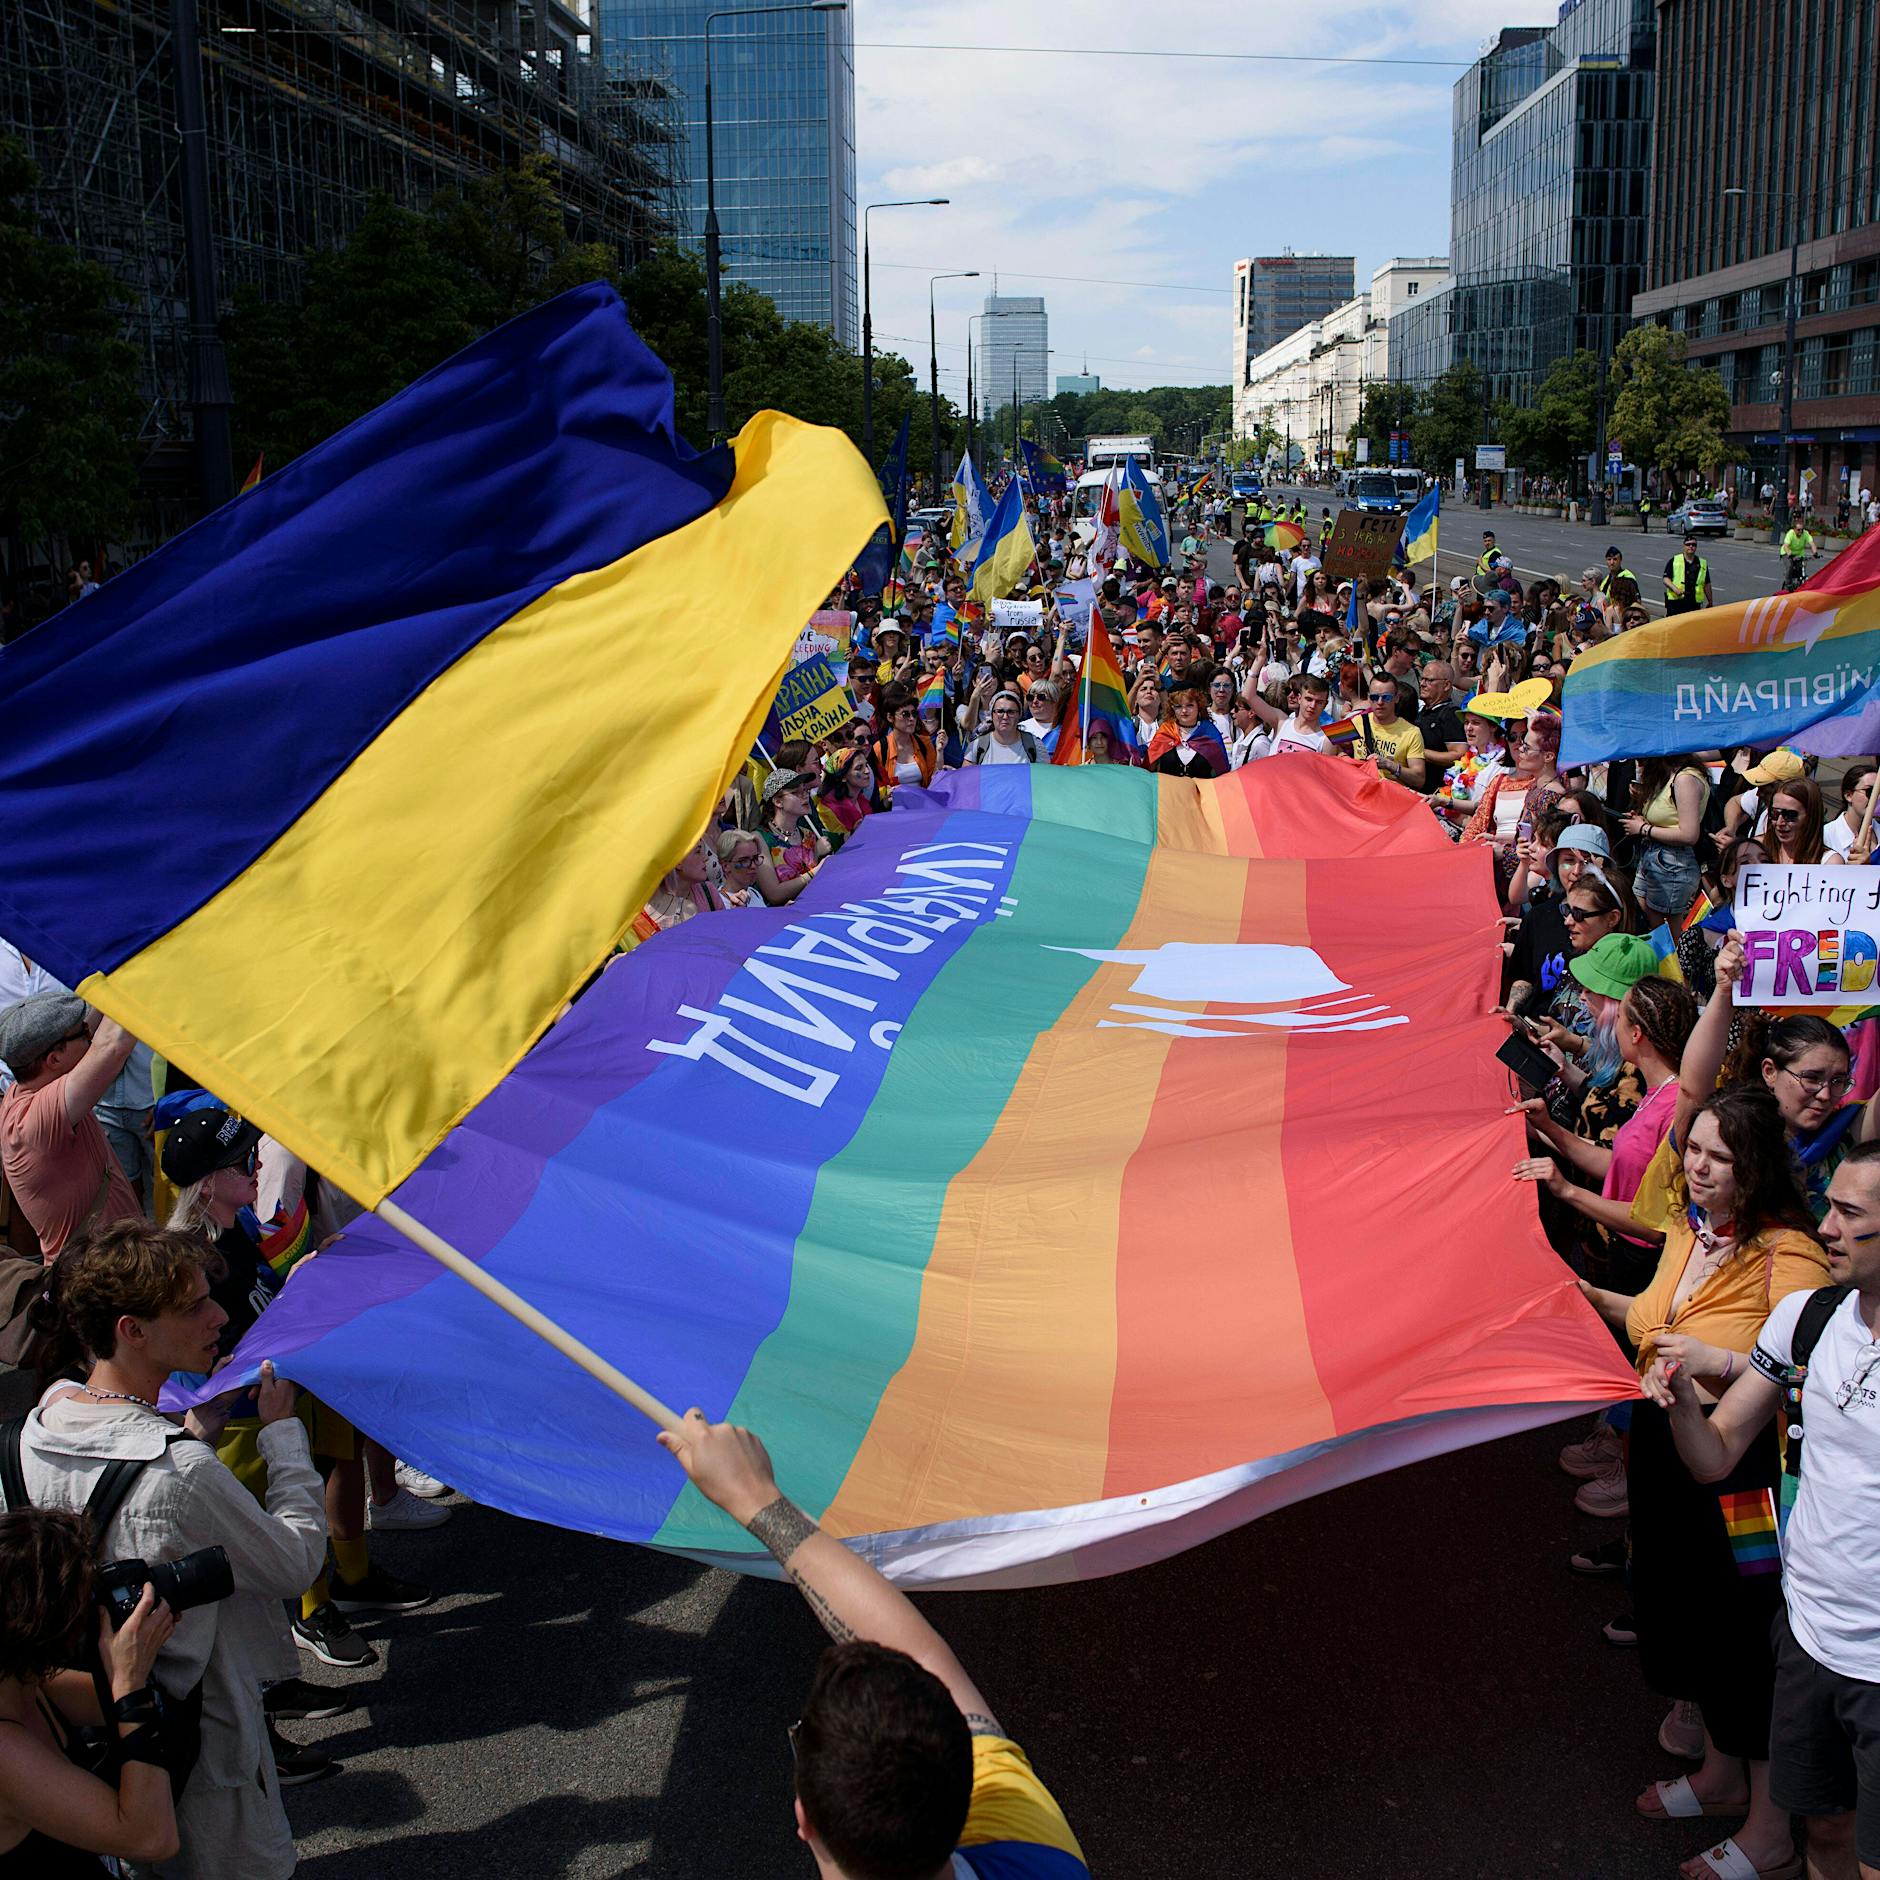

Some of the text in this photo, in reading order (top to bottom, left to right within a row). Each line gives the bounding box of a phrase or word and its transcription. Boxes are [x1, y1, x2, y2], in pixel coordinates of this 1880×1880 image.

[794, 643, 831, 653] LEEDING
[774, 662, 836, 717] РАЇНА
[1743, 872, 1856, 925] Fighting
[1740, 929, 1880, 997] FREED
